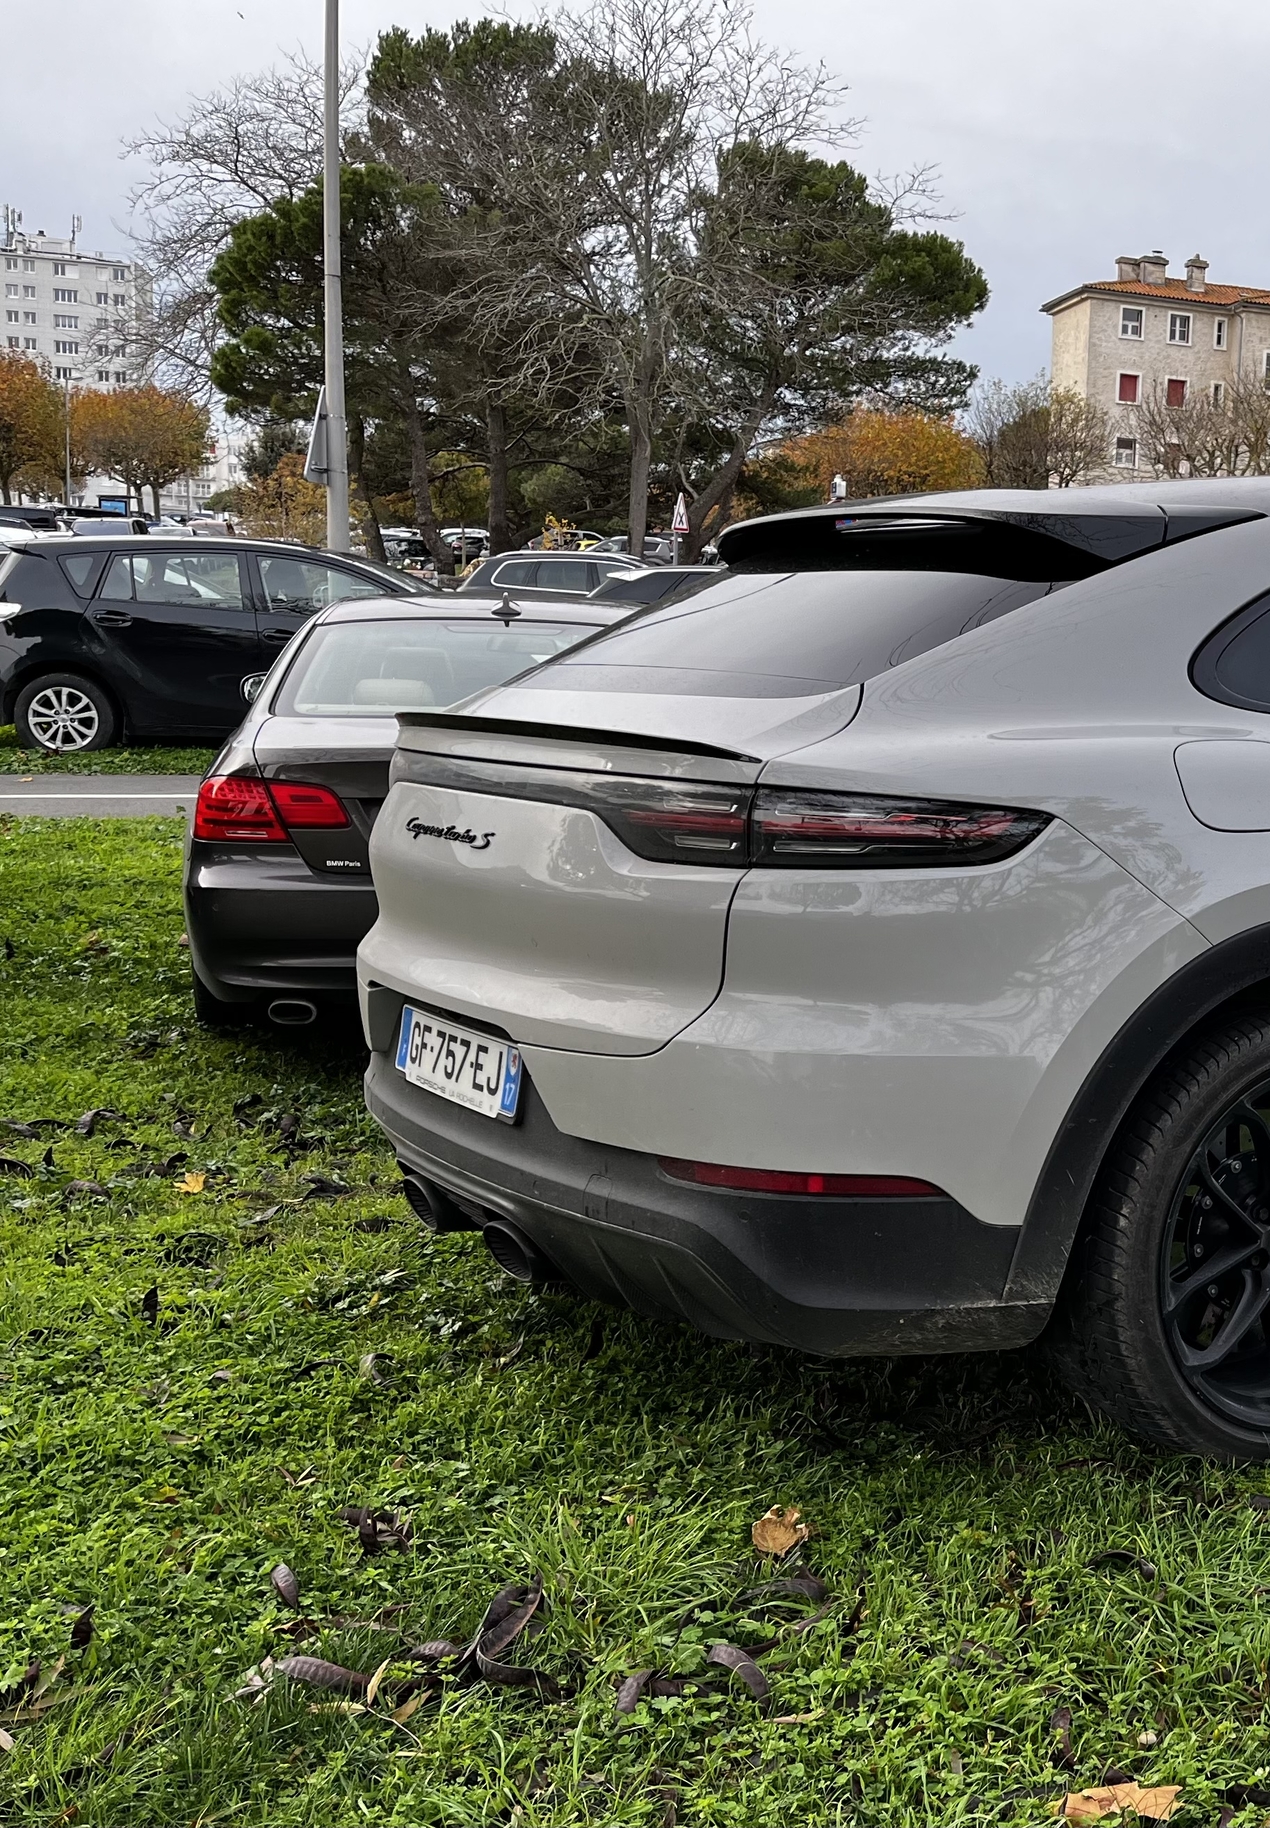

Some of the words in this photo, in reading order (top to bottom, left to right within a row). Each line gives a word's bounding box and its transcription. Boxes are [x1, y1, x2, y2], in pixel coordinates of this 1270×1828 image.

[405, 816, 445, 840] Cayenne
[470, 832, 496, 850] S
[409, 1020, 504, 1097] GF-757-EJ
[415, 1075, 447, 1095] PORSCHE
[503, 1082, 516, 1106] 17
